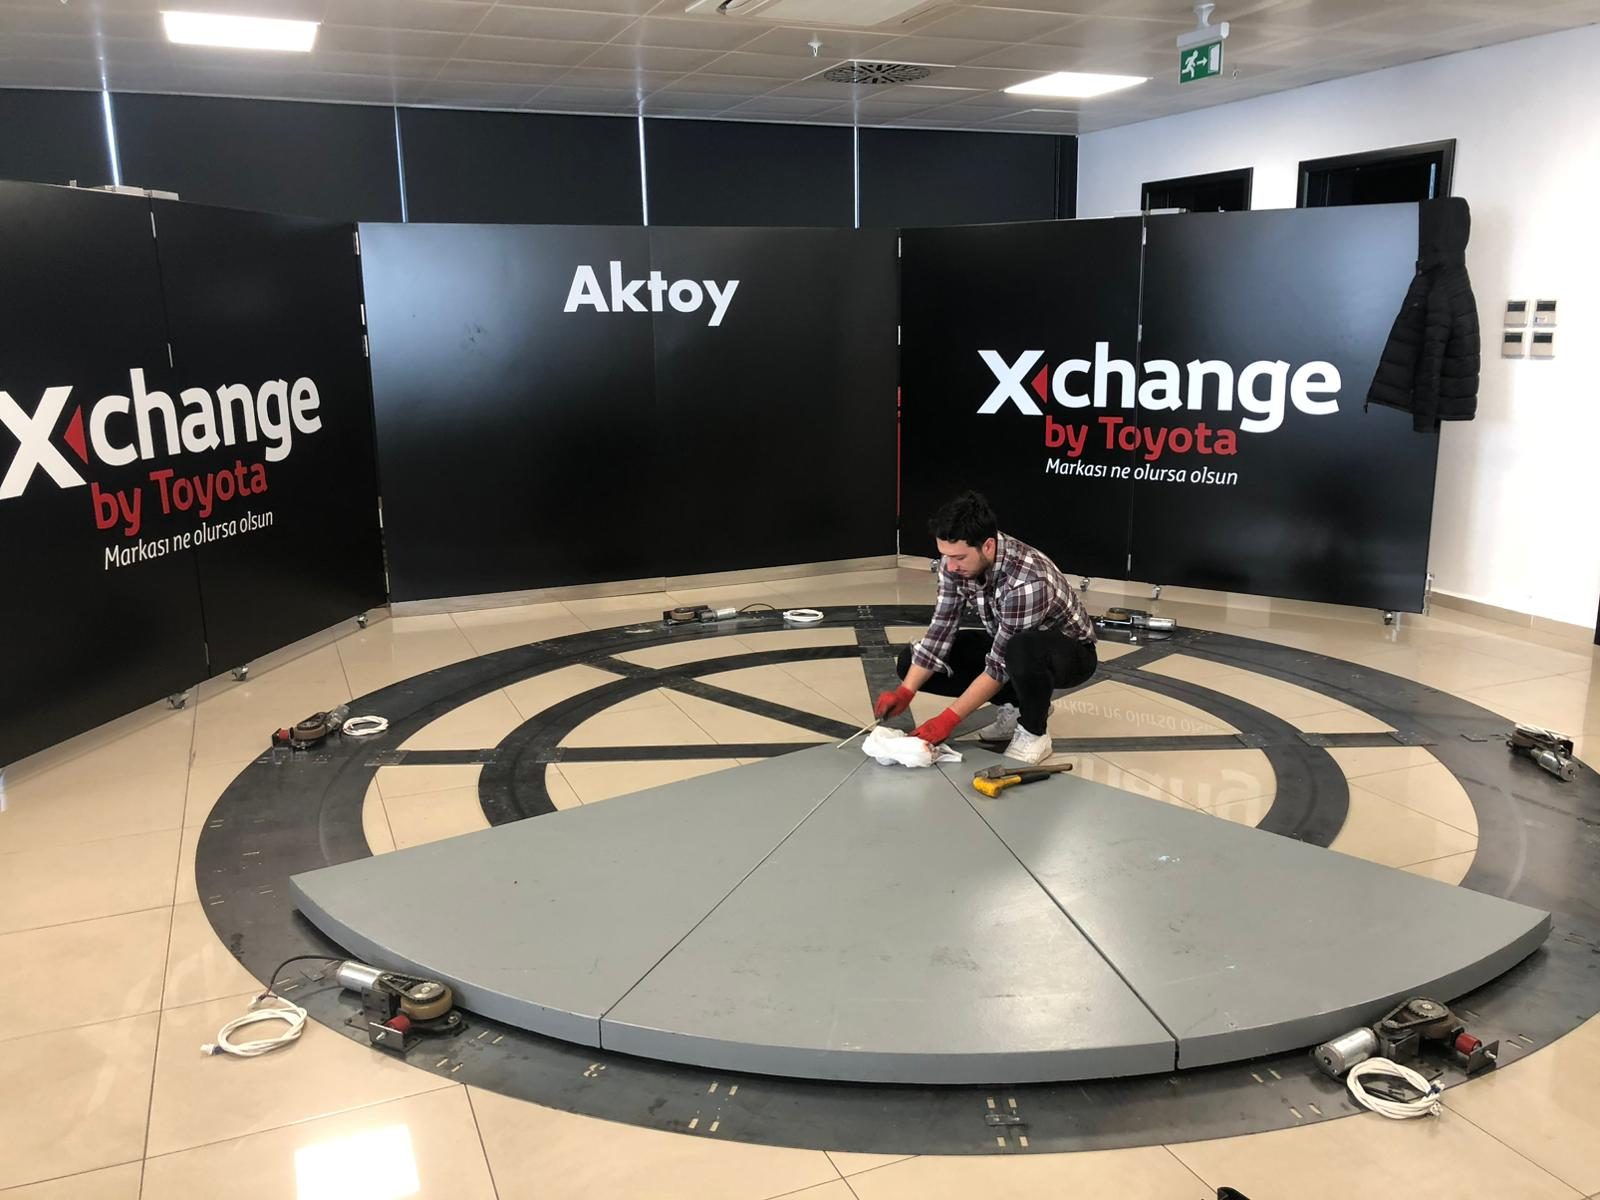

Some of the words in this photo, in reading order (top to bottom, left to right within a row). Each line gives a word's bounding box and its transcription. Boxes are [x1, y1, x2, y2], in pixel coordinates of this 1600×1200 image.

[563, 260, 740, 327] Aktoy
[976, 341, 1342, 434] Xchange
[0, 367, 323, 502] Xchange
[1045, 415, 1089, 458] by
[1098, 416, 1238, 461] Toyota
[90, 482, 142, 537] by
[149, 460, 268, 518] Toyota
[1045, 457, 1108, 478] Markası
[1110, 465, 1131, 479] ne
[1133, 463, 1187, 483] olursa
[1190, 466, 1239, 486] olsun
[104, 538, 170, 571] Markası
[173, 532, 191, 552] ne
[193, 520, 237, 547] olursa
[239, 510, 274, 534] olsun
